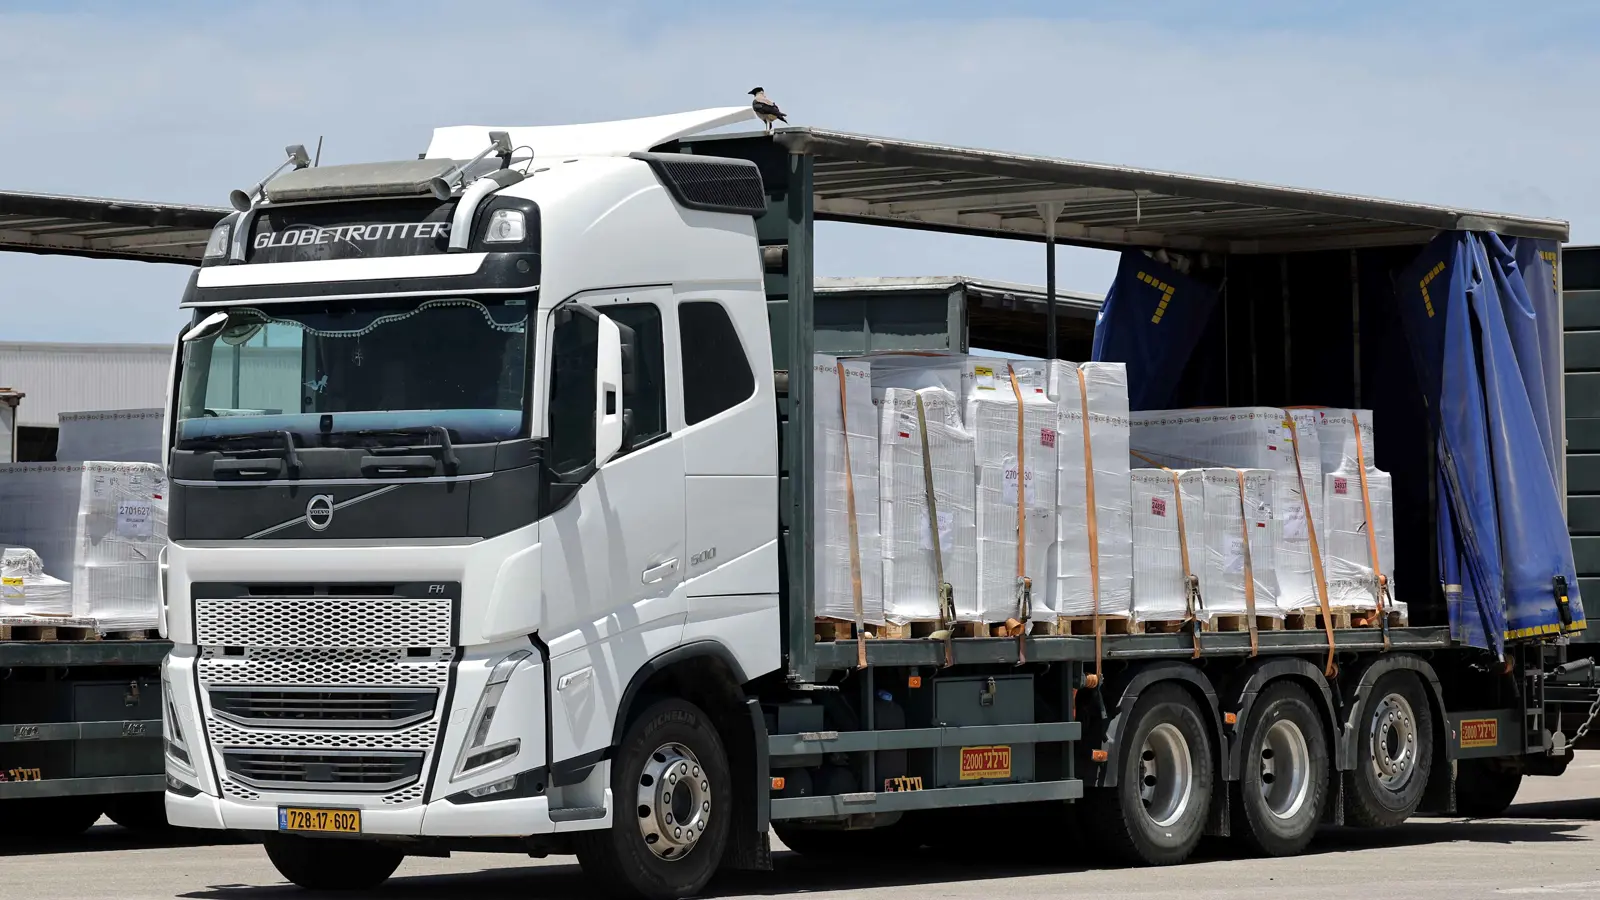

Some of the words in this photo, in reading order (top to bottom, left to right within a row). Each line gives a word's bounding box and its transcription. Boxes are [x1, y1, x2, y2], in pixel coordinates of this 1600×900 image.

[253, 221, 450, 250] GLOBETROTTER
[119, 506, 150, 516] 2701627
[690, 546, 717, 567] 500
[428, 584, 446, 594] FH
[643, 710, 697, 738] MICHELIN
[965, 753, 983, 770] 2000
